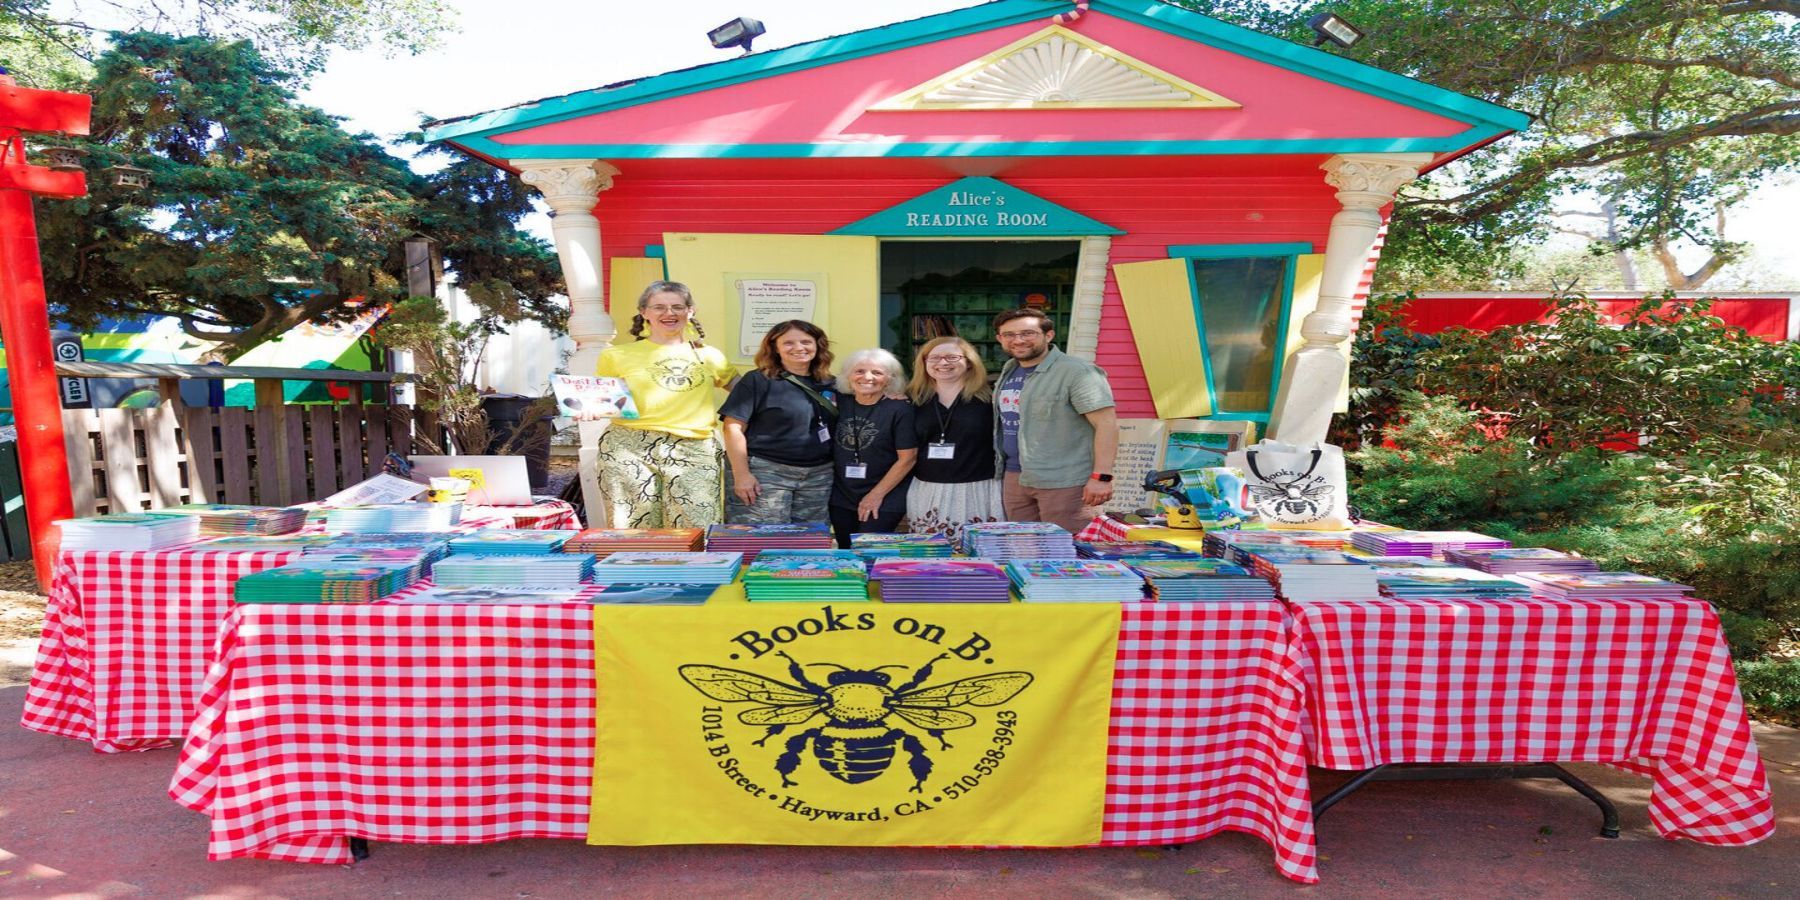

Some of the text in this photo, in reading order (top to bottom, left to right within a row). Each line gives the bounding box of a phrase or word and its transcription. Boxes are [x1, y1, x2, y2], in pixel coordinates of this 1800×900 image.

[949, 191, 1005, 206] Alice's
[906, 212, 1048, 227] READING ROOM
[893, 617, 946, 645] on
[701, 705, 1018, 822] 1014 B Street Hayward, CA 510-538-3943
